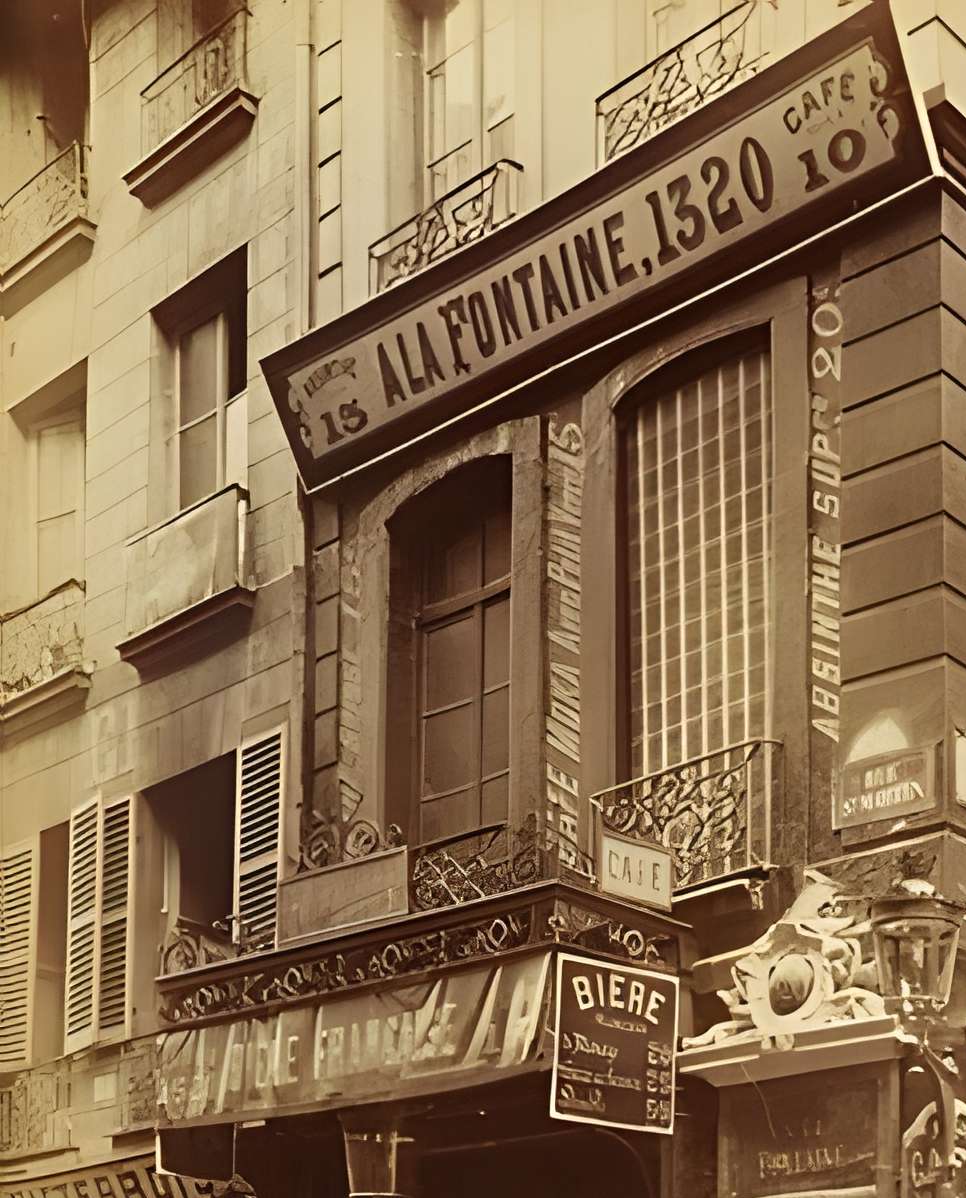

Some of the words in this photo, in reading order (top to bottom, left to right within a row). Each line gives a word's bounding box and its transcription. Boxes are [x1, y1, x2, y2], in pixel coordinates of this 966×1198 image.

[783, 72, 855, 134] CAFE
[797, 128, 867, 193] 10
[812, 535, 841, 743] ABSINTHE
[572, 973, 665, 1025] BIERE
